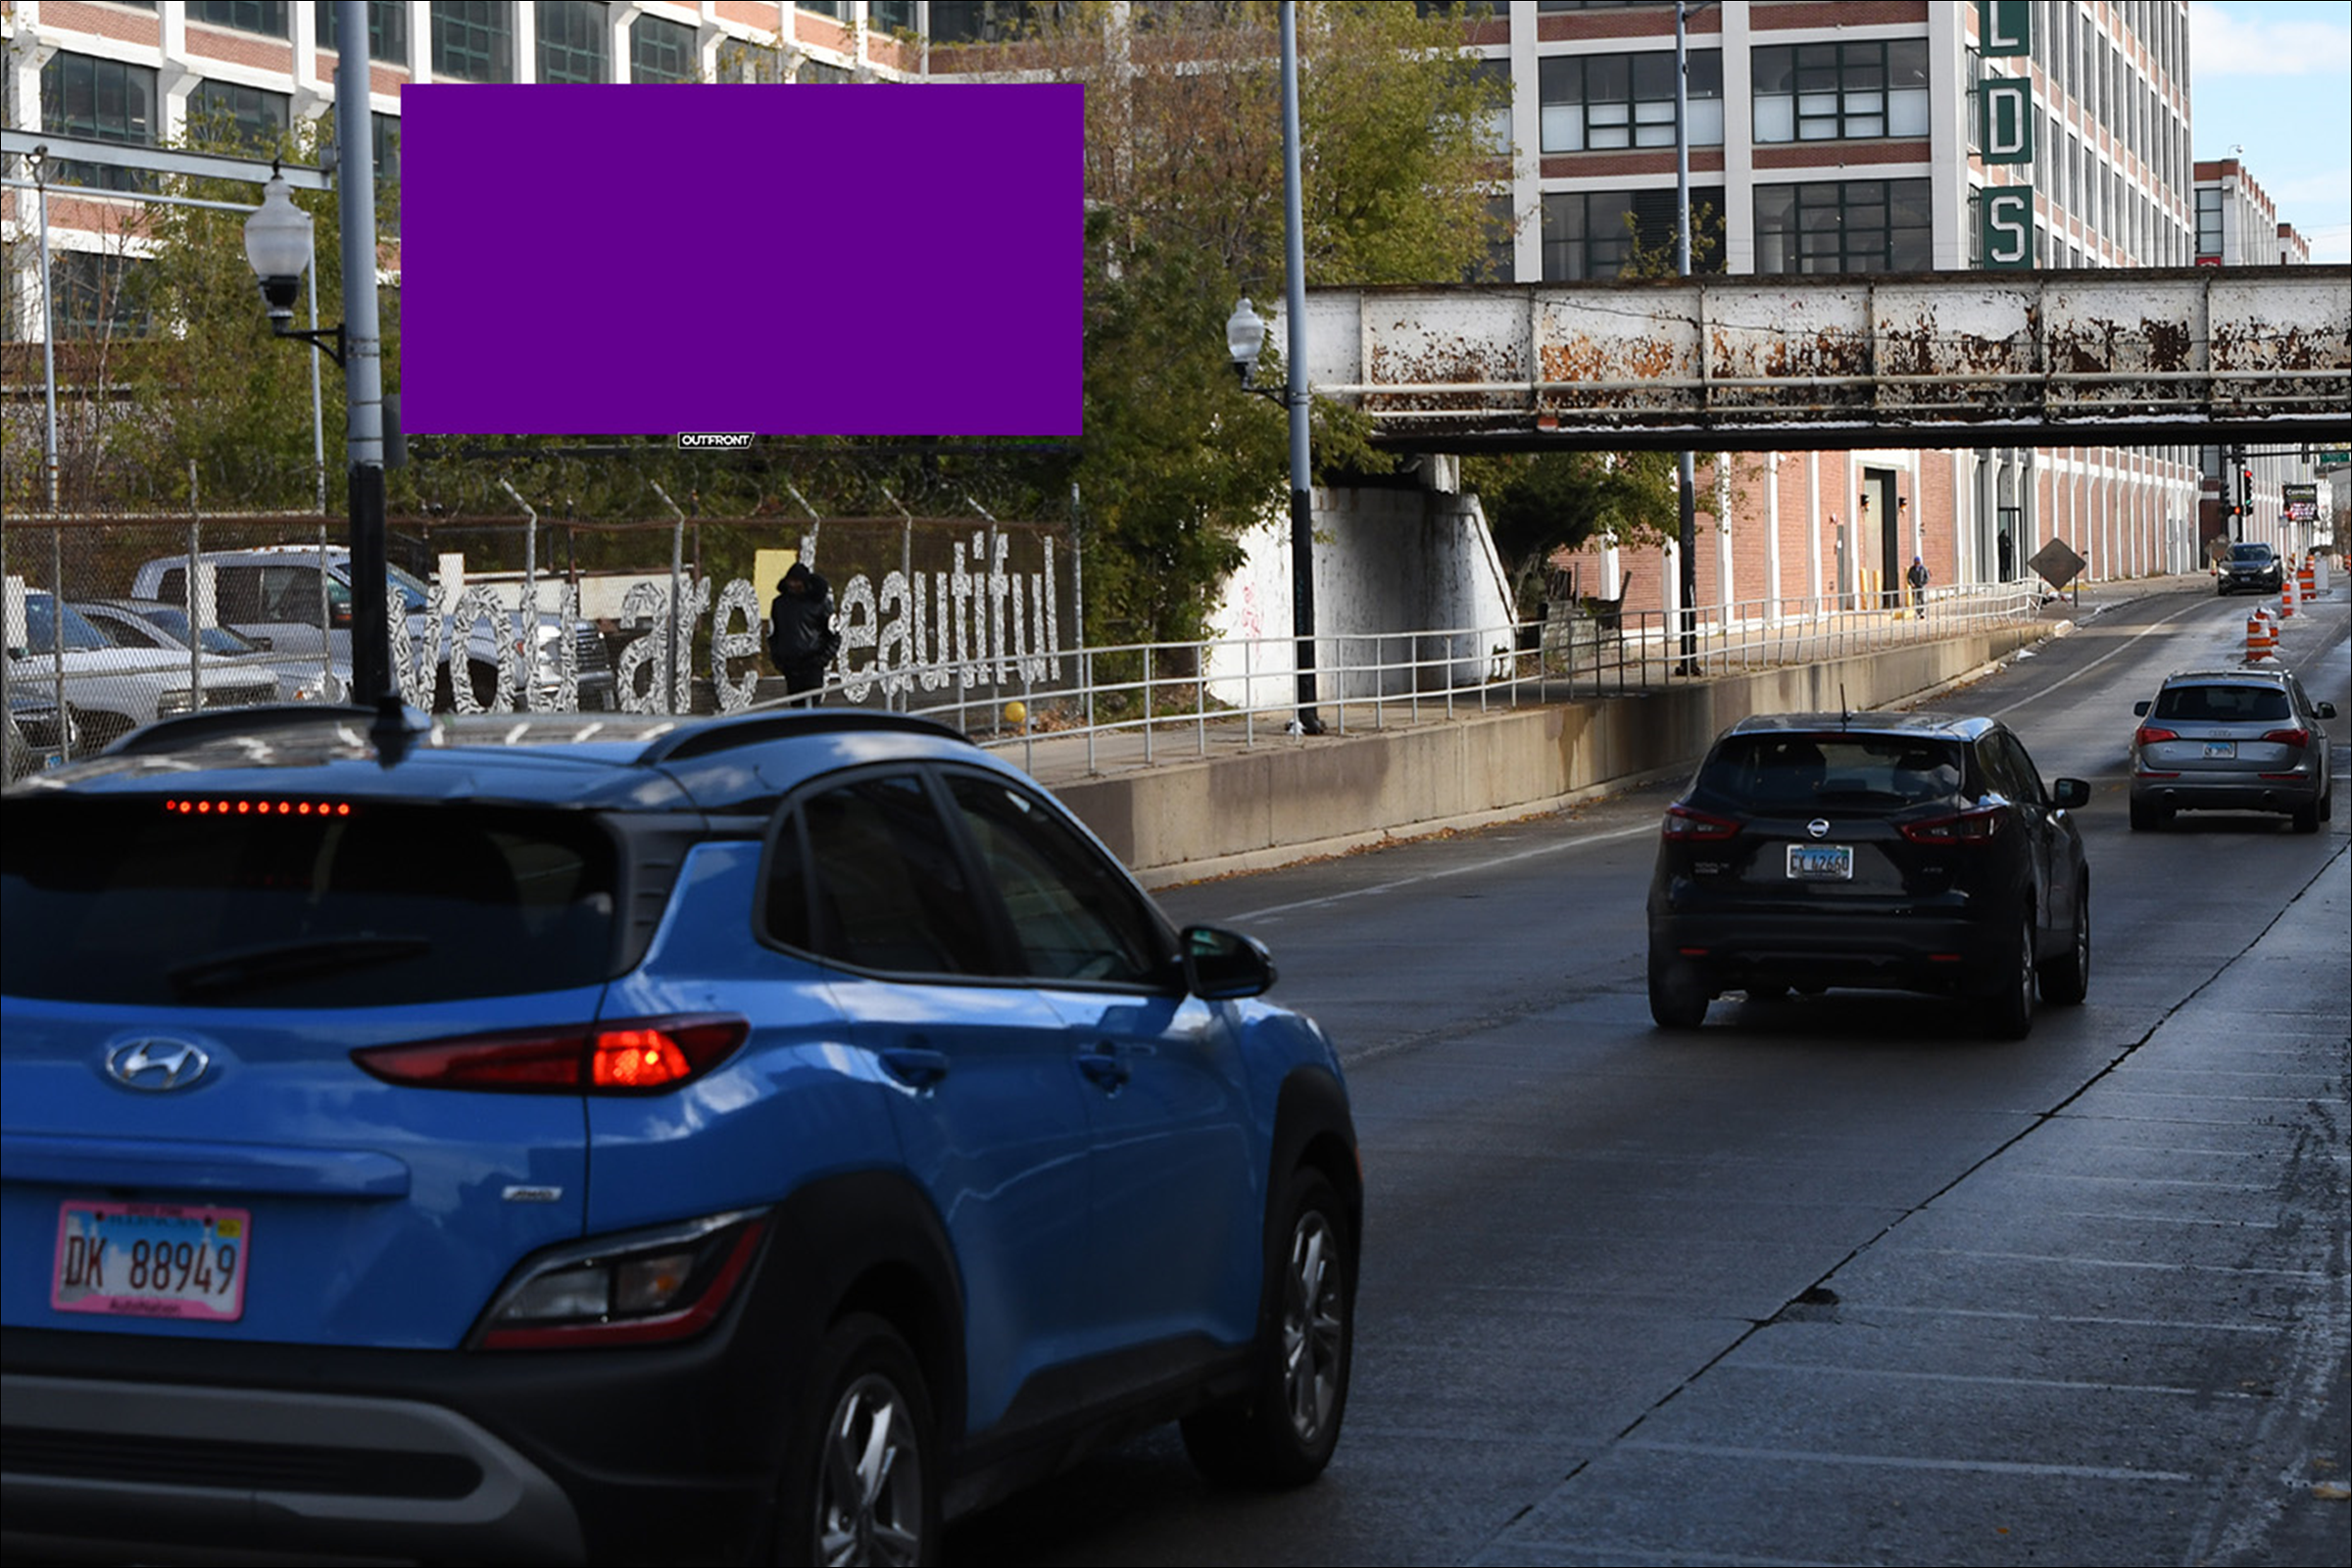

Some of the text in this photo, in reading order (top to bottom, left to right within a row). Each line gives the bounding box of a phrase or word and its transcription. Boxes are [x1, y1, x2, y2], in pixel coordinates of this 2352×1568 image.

[681, 434, 751, 446] OUTFRONT
[617, 576, 761, 713] are
[800, 531, 1061, 704] eautiful
[65, 1235, 237, 1296] DK 88949
